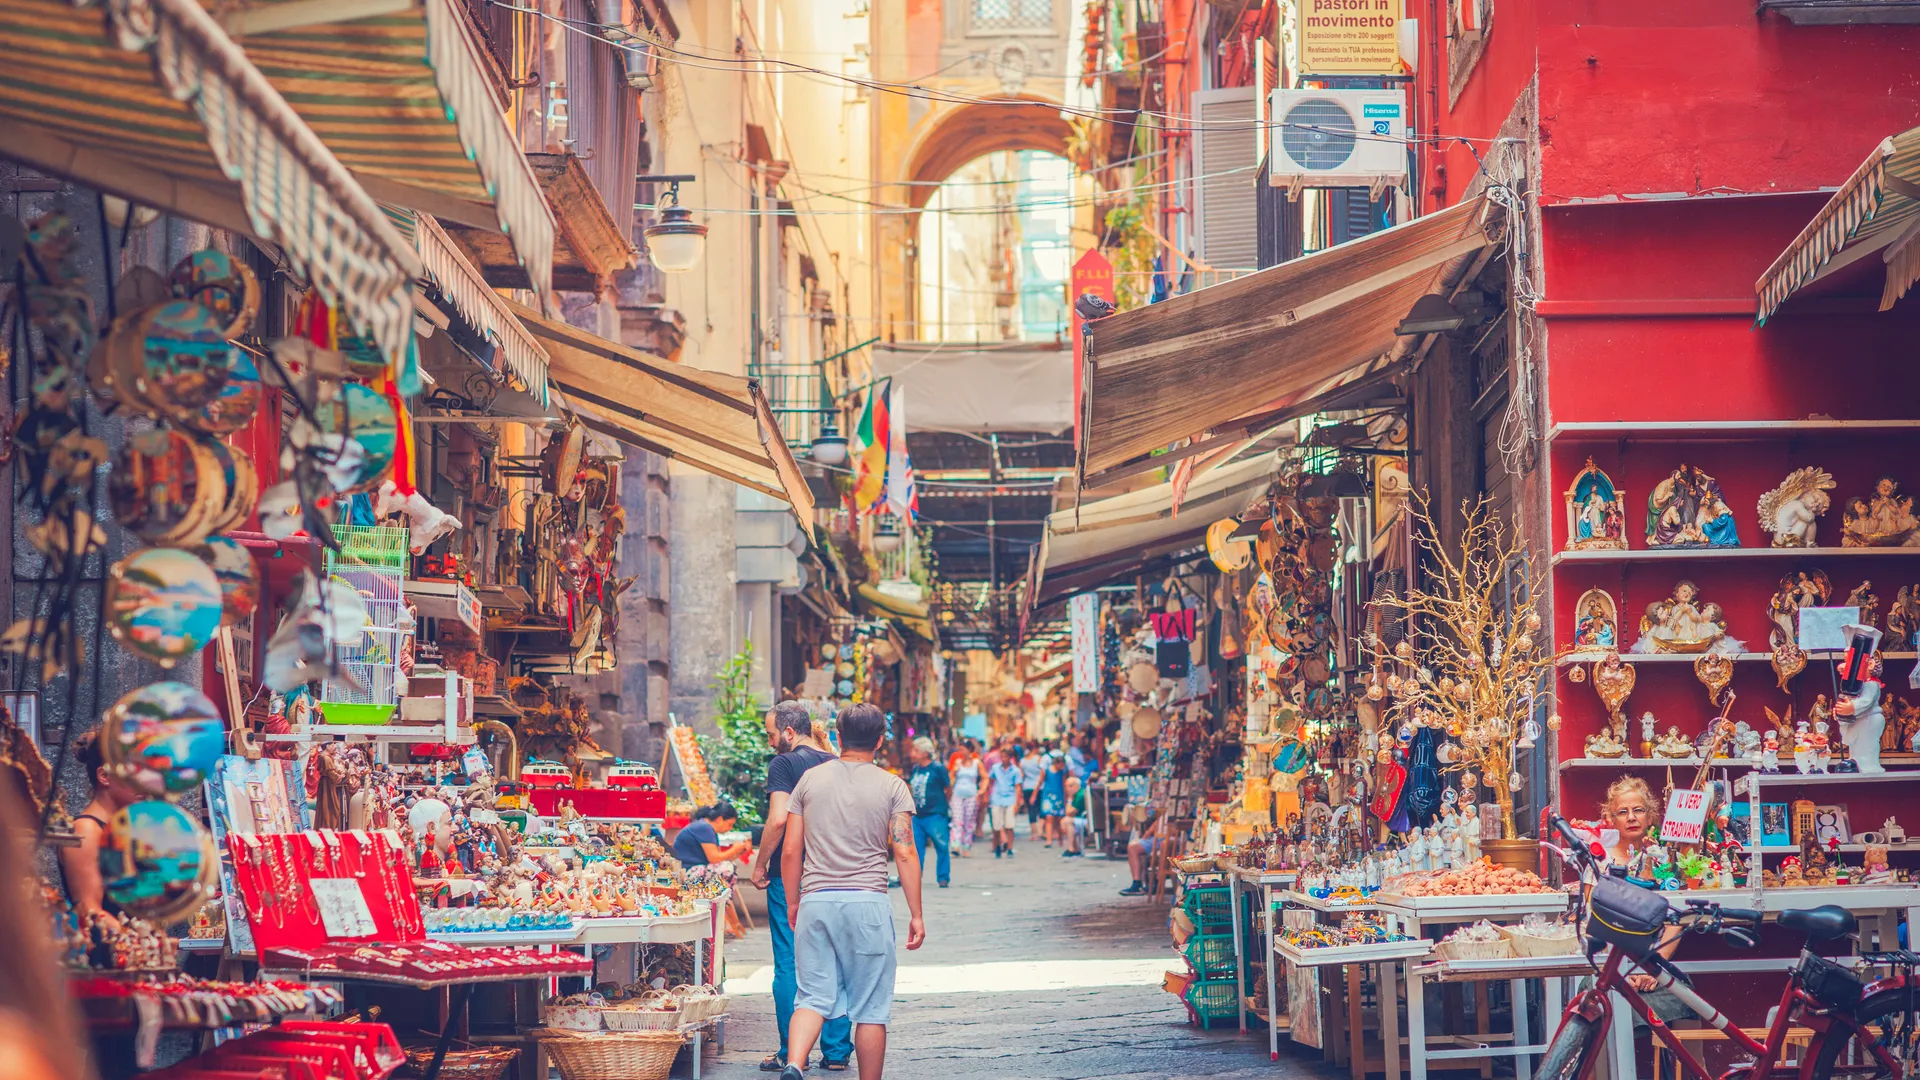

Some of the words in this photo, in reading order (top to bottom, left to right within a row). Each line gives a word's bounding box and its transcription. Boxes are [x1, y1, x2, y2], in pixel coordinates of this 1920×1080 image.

[1314, 0, 1369, 13] pastori
[1375, 0, 1388, 10] in
[1307, 13, 1394, 27] movimento
[1370, 32, 1395, 41] soggetti
[1362, 46, 1395, 55] professione
[1684, 794, 1702, 809] VERO
